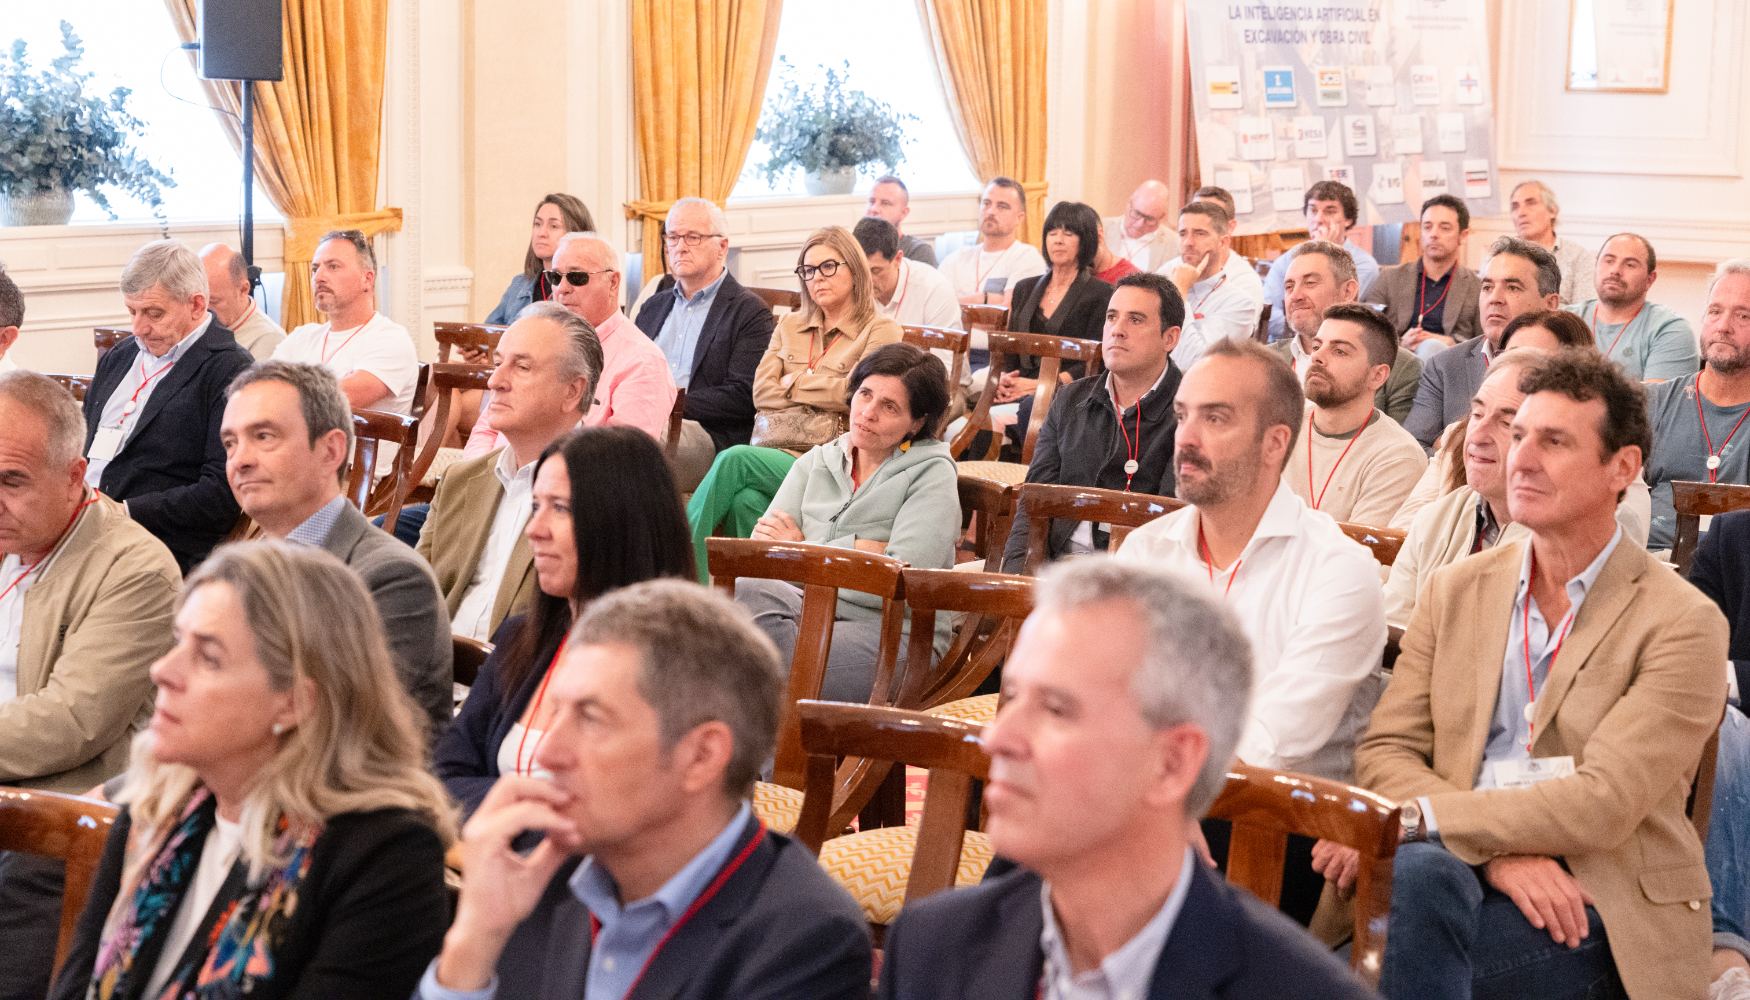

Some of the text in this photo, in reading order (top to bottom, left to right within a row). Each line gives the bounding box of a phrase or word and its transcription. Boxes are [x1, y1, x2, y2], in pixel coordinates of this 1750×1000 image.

[1228, 5, 1380, 22] LA INTELIGENCIA ARTIFICIAL EN
[1244, 26, 1371, 45] EXCAVACIÓN Y OBRA CIVIL
